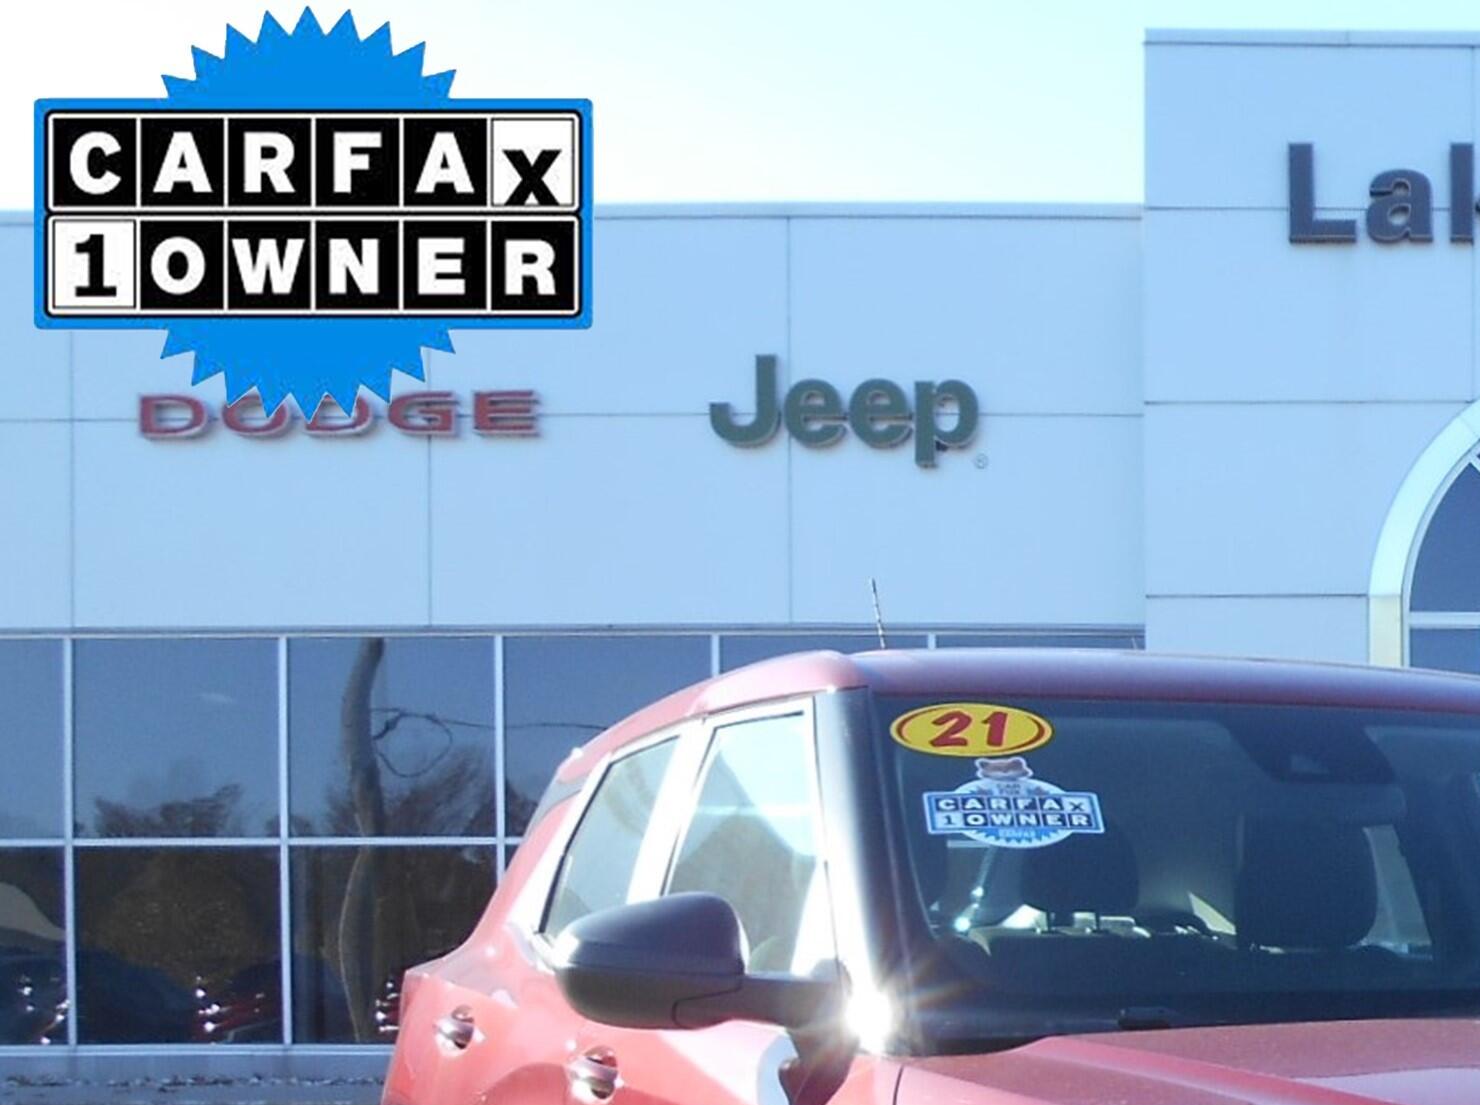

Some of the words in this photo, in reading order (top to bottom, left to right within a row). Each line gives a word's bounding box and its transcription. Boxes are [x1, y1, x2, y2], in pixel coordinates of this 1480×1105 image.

[709, 354, 979, 467] Jeep
[930, 710, 1009, 748] 21
[938, 797, 1085, 813] CARFAX
